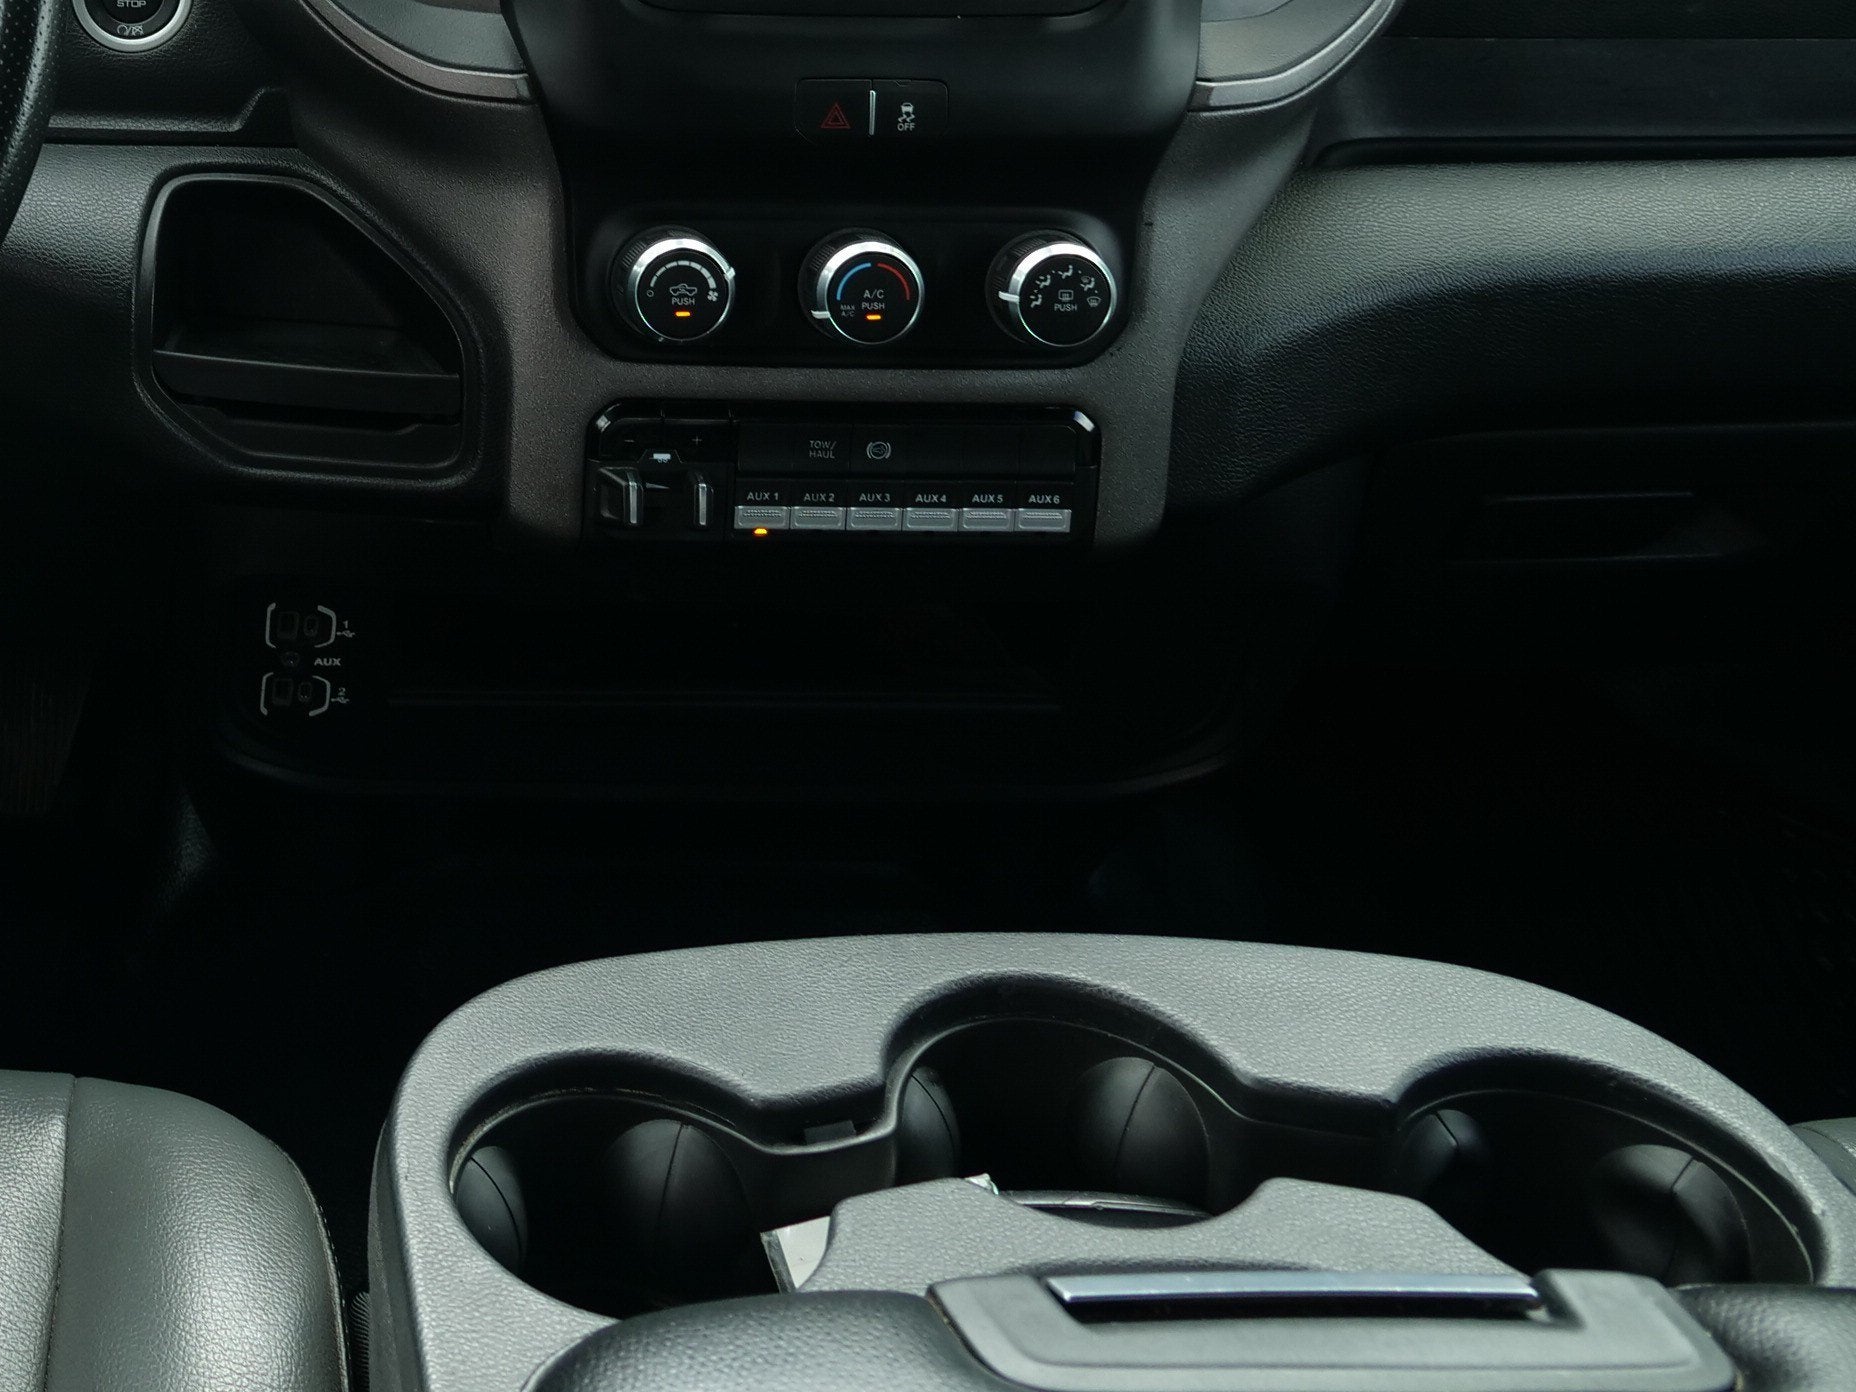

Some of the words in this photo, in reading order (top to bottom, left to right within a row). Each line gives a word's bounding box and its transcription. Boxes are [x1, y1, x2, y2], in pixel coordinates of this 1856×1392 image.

[116, 0, 147, 8] STOP
[897, 122, 915, 131] OFF
[863, 289, 884, 299] A/C
[672, 297, 695, 306] PUSH
[861, 302, 885, 310] PUSH
[809, 440, 837, 449] TOW/
[809, 450, 835, 459] HAUL
[746, 492, 770, 501] AUX
[773, 492, 779, 500] 1
[803, 493, 826, 502] AUX
[828, 493, 835, 502] 2
[859, 493, 882, 502] AUX
[884, 494, 891, 502] 3
[915, 494, 939, 503] AUX
[971, 494, 994, 503] AUX
[996, 494, 1004, 503] 5
[1028, 495, 1052, 503] AUX
[1053, 495, 1060, 504] 6
[314, 658, 341, 666] AUX
